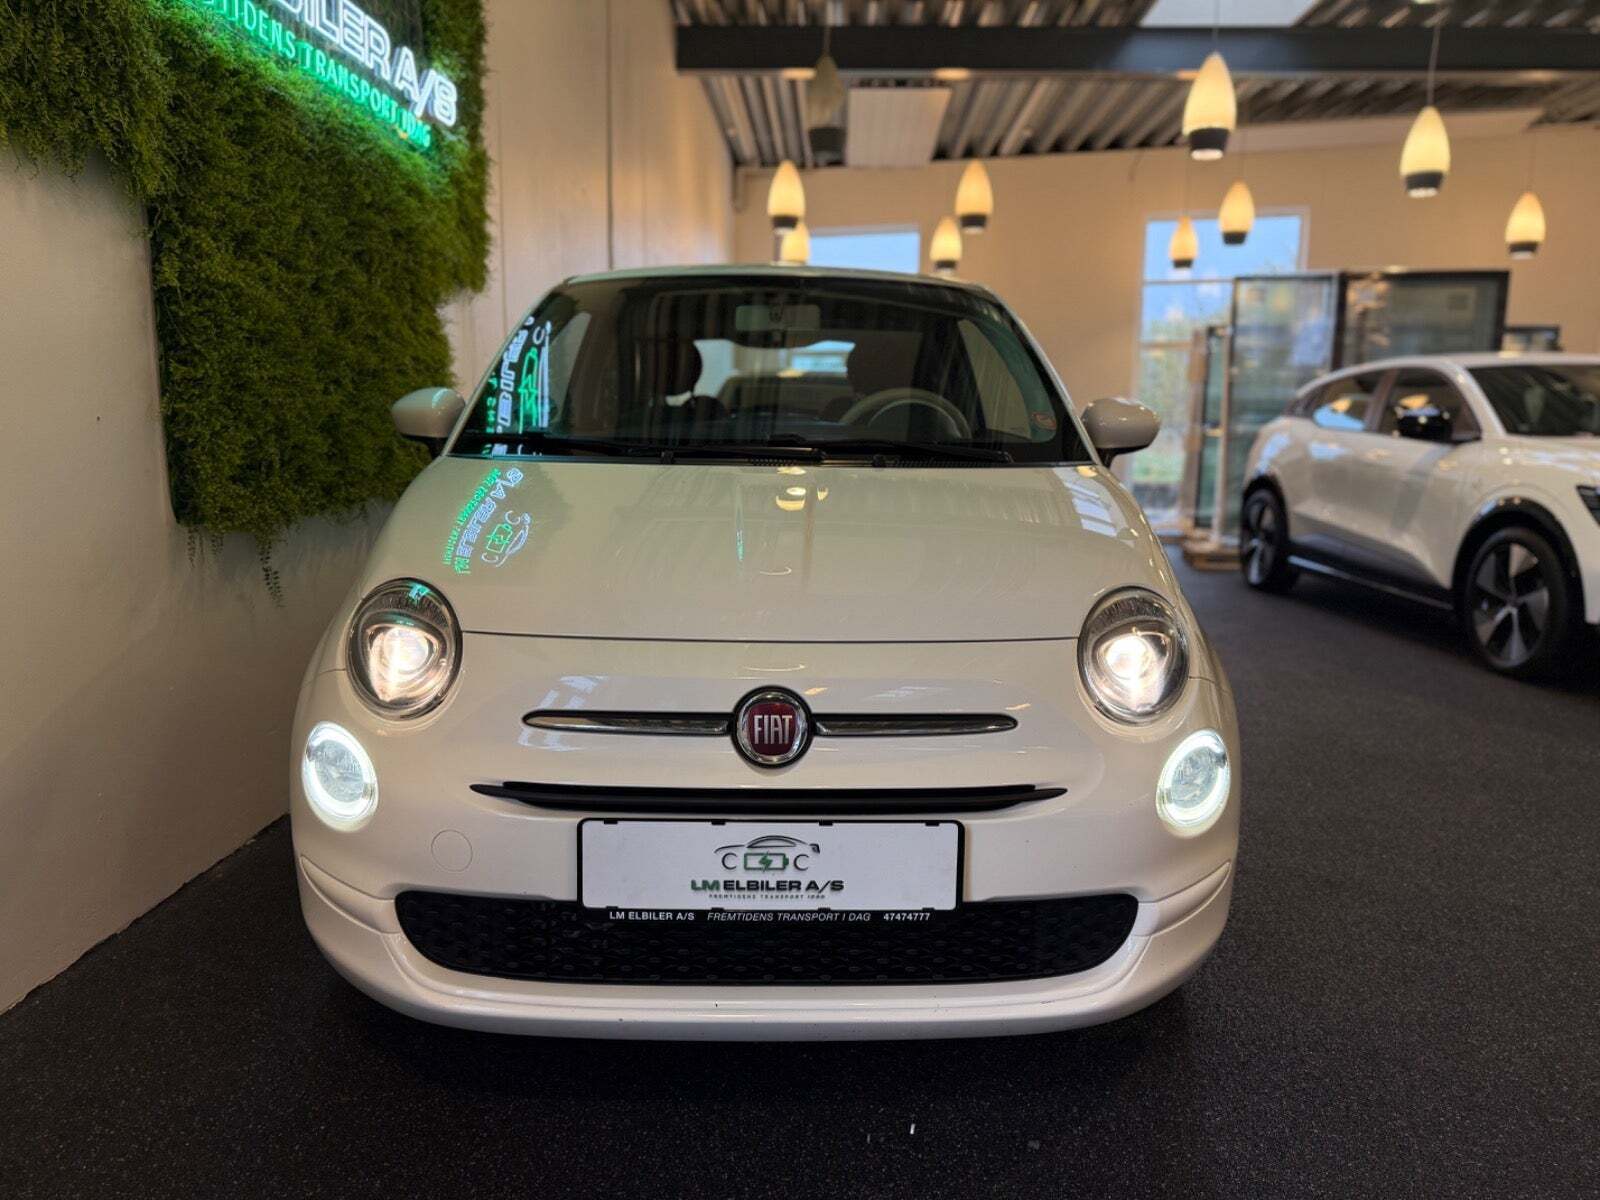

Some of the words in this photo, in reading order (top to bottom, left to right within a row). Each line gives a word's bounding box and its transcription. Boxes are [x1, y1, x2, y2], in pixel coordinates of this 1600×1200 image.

[299, 42, 398, 123] TRANSPORT
[753, 714, 793, 745] FIAT
[690, 879, 721, 892] LM
[723, 879, 802, 892] ELBILER
[805, 879, 845, 894] A/S
[609, 911, 625, 920] LM
[628, 911, 673, 921] ELBILER
[675, 911, 695, 921] A/S
[706, 912, 774, 922] FREMTIDENS
[777, 912, 840, 922] TRANSPORT
[848, 912, 872, 922] DAG
[883, 912, 931, 921] 47474777
